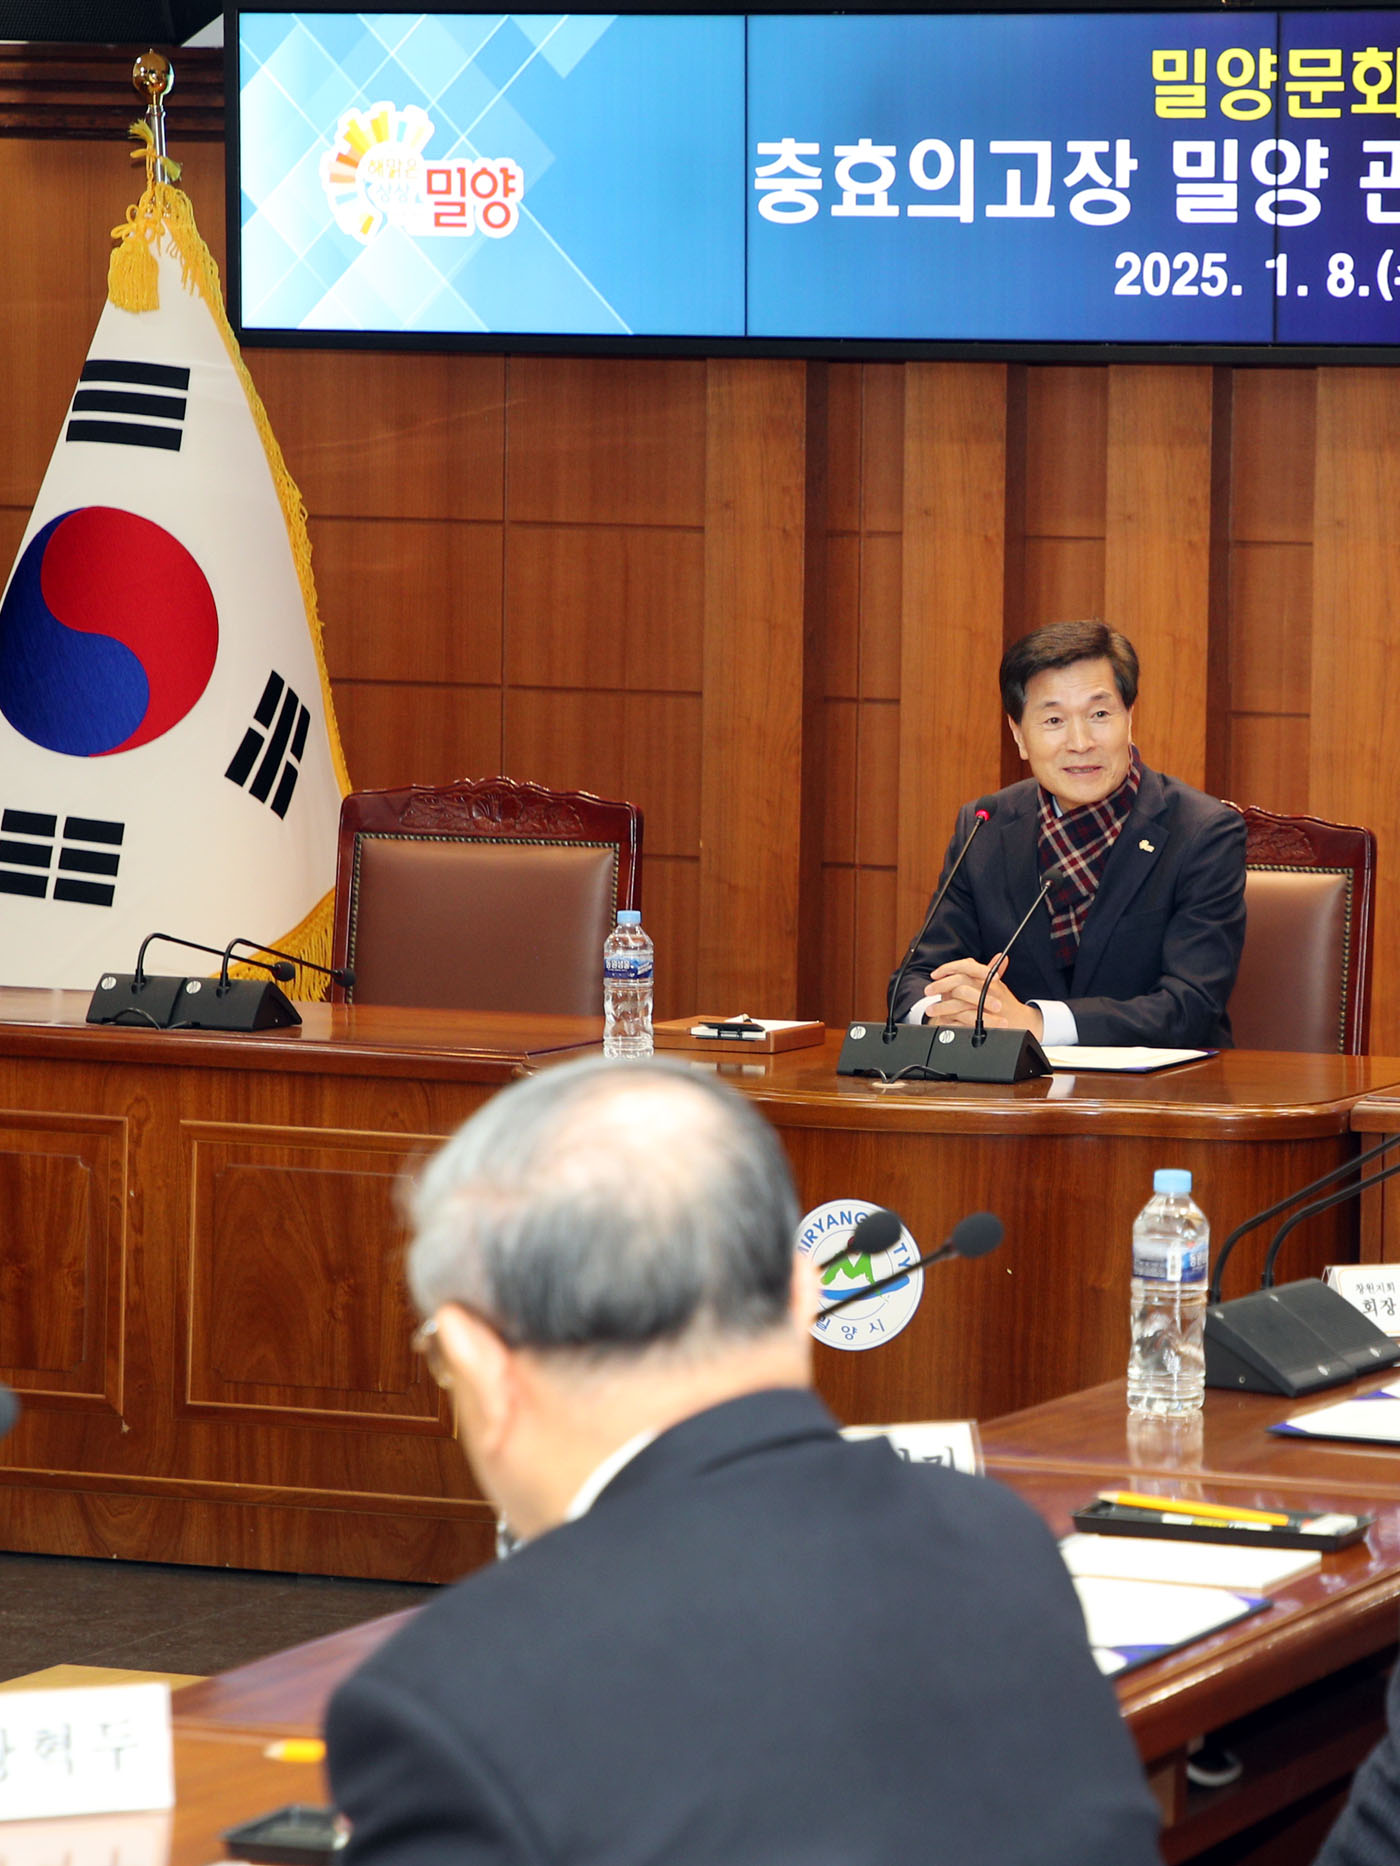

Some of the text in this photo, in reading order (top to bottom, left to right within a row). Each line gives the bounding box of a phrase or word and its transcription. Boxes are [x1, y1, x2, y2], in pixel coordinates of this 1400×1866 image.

[426, 165, 517, 229] 밀양
[754, 137, 1138, 226] 충효의고장
[1172, 138, 1329, 227] 밀양
[1114, 251, 1243, 297] 2025.
[1265, 253, 1308, 297] 1.
[798, 1210, 869, 1256] IRYANG
[1362, 1297, 1397, 1317] 회장
